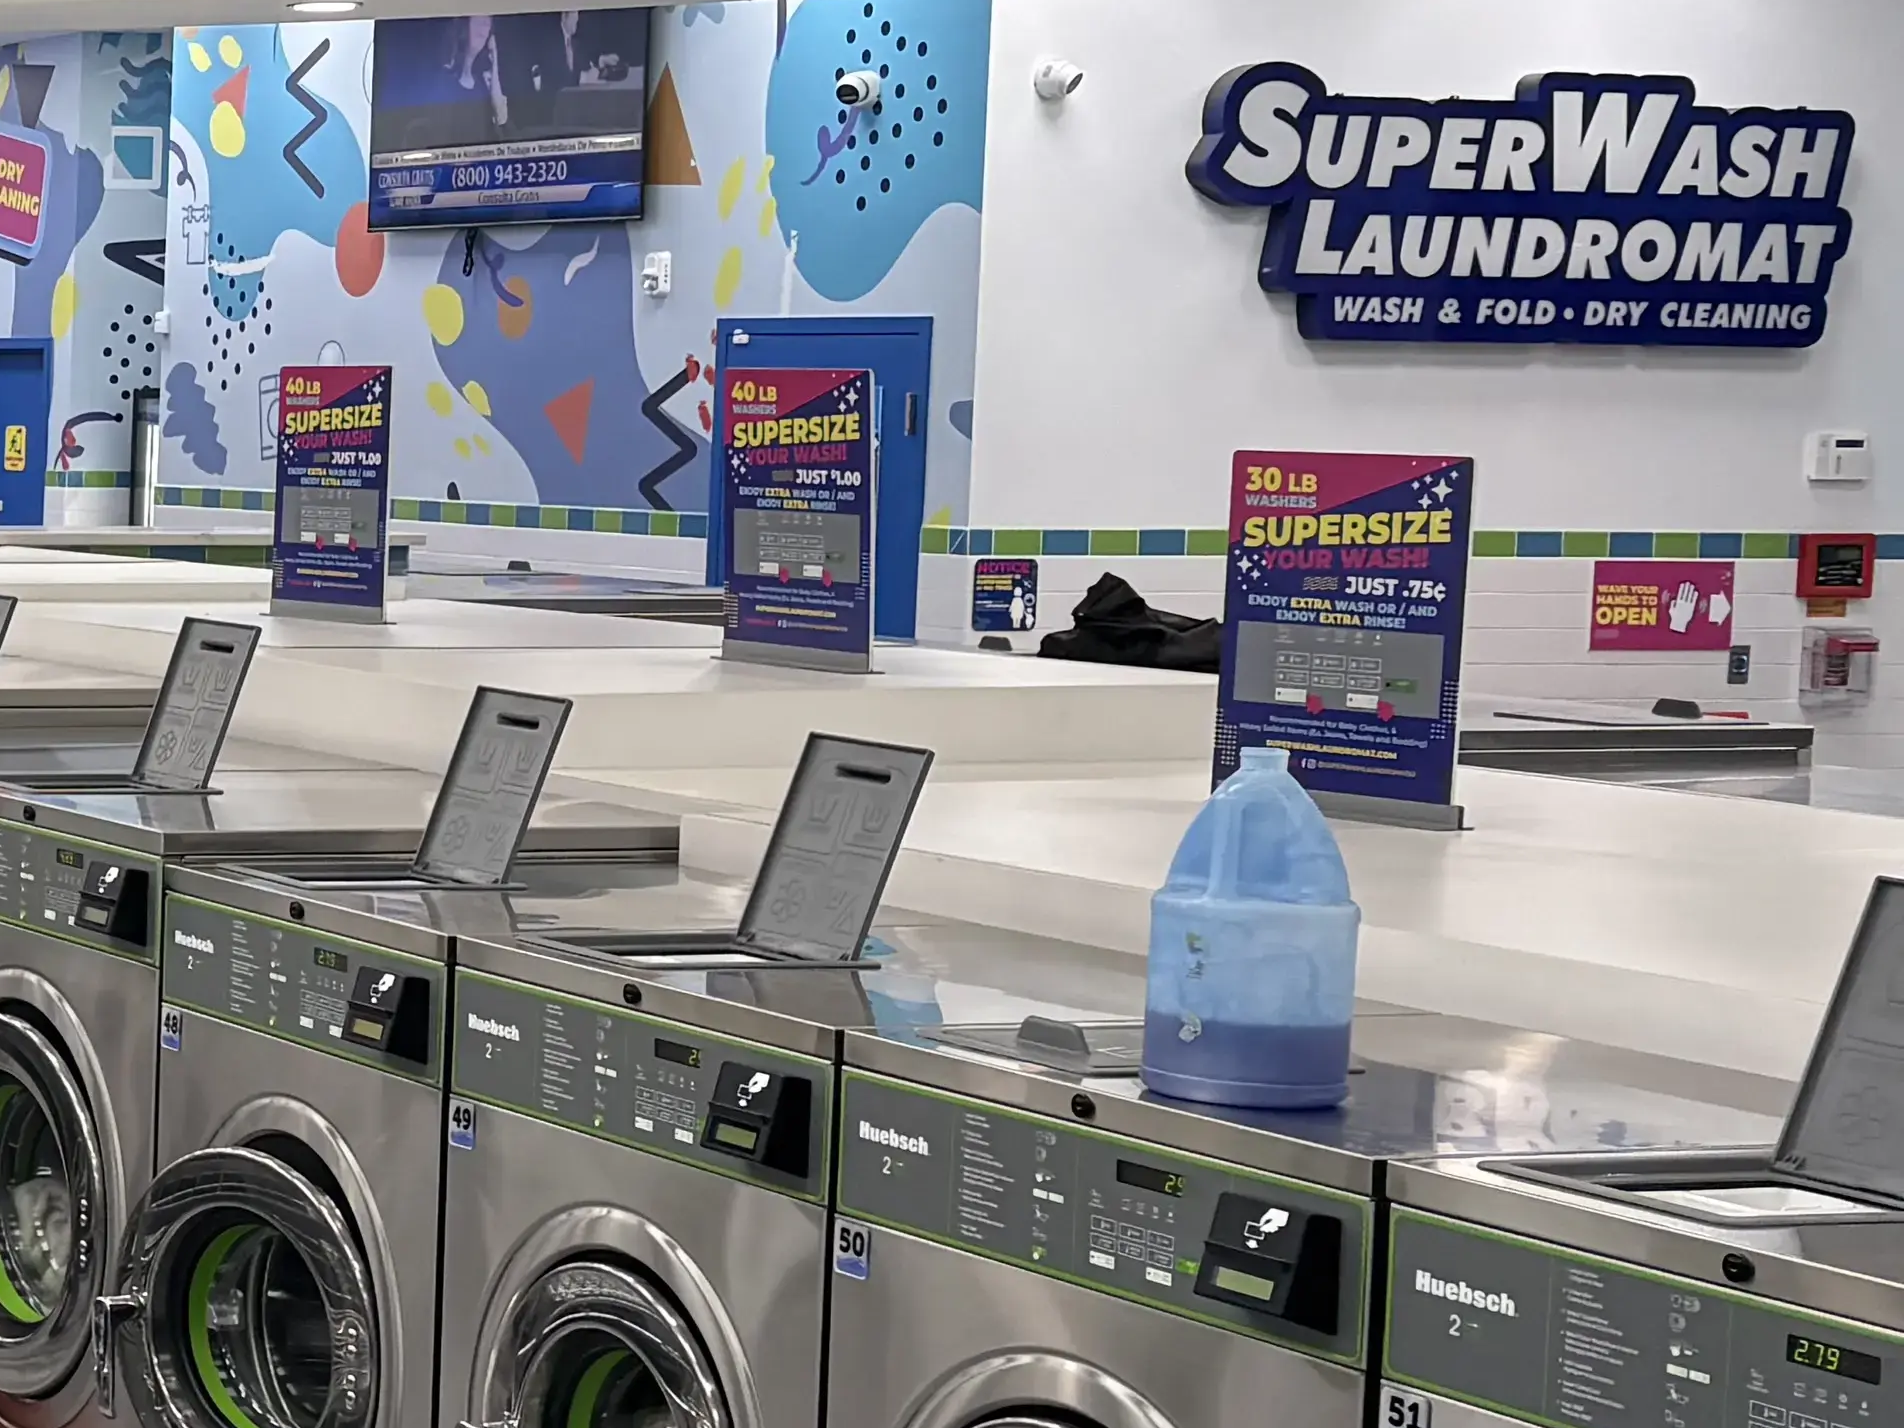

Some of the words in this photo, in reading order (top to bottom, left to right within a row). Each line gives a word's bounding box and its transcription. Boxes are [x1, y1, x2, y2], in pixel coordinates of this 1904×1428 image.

[452, 165, 490, 188] (800)
[494, 160, 567, 185] 943-2320
[1295, 199, 1837, 283] LAUNDROMAT
[1334, 296, 1424, 323] WASH
[1437, 298, 1462, 324] &
[1476, 298, 1556, 325] FOLD
[1583, 300, 1649, 326] DRY
[1660, 301, 1812, 330] CLEANING
[285, 376, 305, 395] 40
[306, 381, 321, 395] LB
[731, 381, 756, 402] 40
[759, 386, 777, 402] LB
[285, 402, 383, 435] SUPERSIZE
[295, 433, 328, 449] YOUR
[330, 430, 372, 448] WASH!
[733, 413, 860, 448] SUPERSIZE
[331, 451, 356, 465] JUST
[747, 447, 789, 466] YOUR
[793, 443, 847, 464] WASH!
[795, 469, 828, 485] JUST
[831, 470, 862, 486] $1.00
[1245, 466, 1282, 492] 30
[1288, 473, 1318, 493] LB
[837, 491, 855, 501] AND
[1245, 494, 1317, 509] WASHERS
[1243, 510, 1452, 547] SUPERSIZE
[978, 562, 1030, 574] NOTICE
[1264, 548, 1333, 570] YOUR
[1342, 547, 1430, 569] WASH!
[1345, 576, 1399, 596] JUST
[1402, 580, 1446, 602] .75¢
[1596, 594, 1638, 605] HANDS
[1642, 595, 1658, 606] TO
[1597, 584, 1628, 593] WAVE
[1630, 585, 1659, 594] YOUR
[1248, 594, 1288, 607] ENJOY
[1290, 597, 1332, 611] EXTRA
[1335, 600, 1374, 613] WASH
[1377, 603, 1396, 615] OR
[1398, 603, 1406, 616] /
[1408, 605, 1438, 617] AND
[1595, 606, 1657, 626] OPEN
[1276, 609, 1317, 622] ENJOY
[1319, 613, 1361, 626] EXTRA
[1363, 616, 1406, 629] RINSE!
[163, 1011, 178, 1035] 48
[468, 1012, 520, 1042] Huebsch
[485, 1043, 493, 1059] 2
[451, 1105, 472, 1130] 49
[859, 1120, 930, 1156] Huebsch
[882, 1156, 893, 1176] 2
[838, 1227, 865, 1258] 50
[1415, 1269, 1516, 1317] Huebsch
[1448, 1314, 1461, 1337] 2
[1793, 1339, 1840, 1371] 2.79
